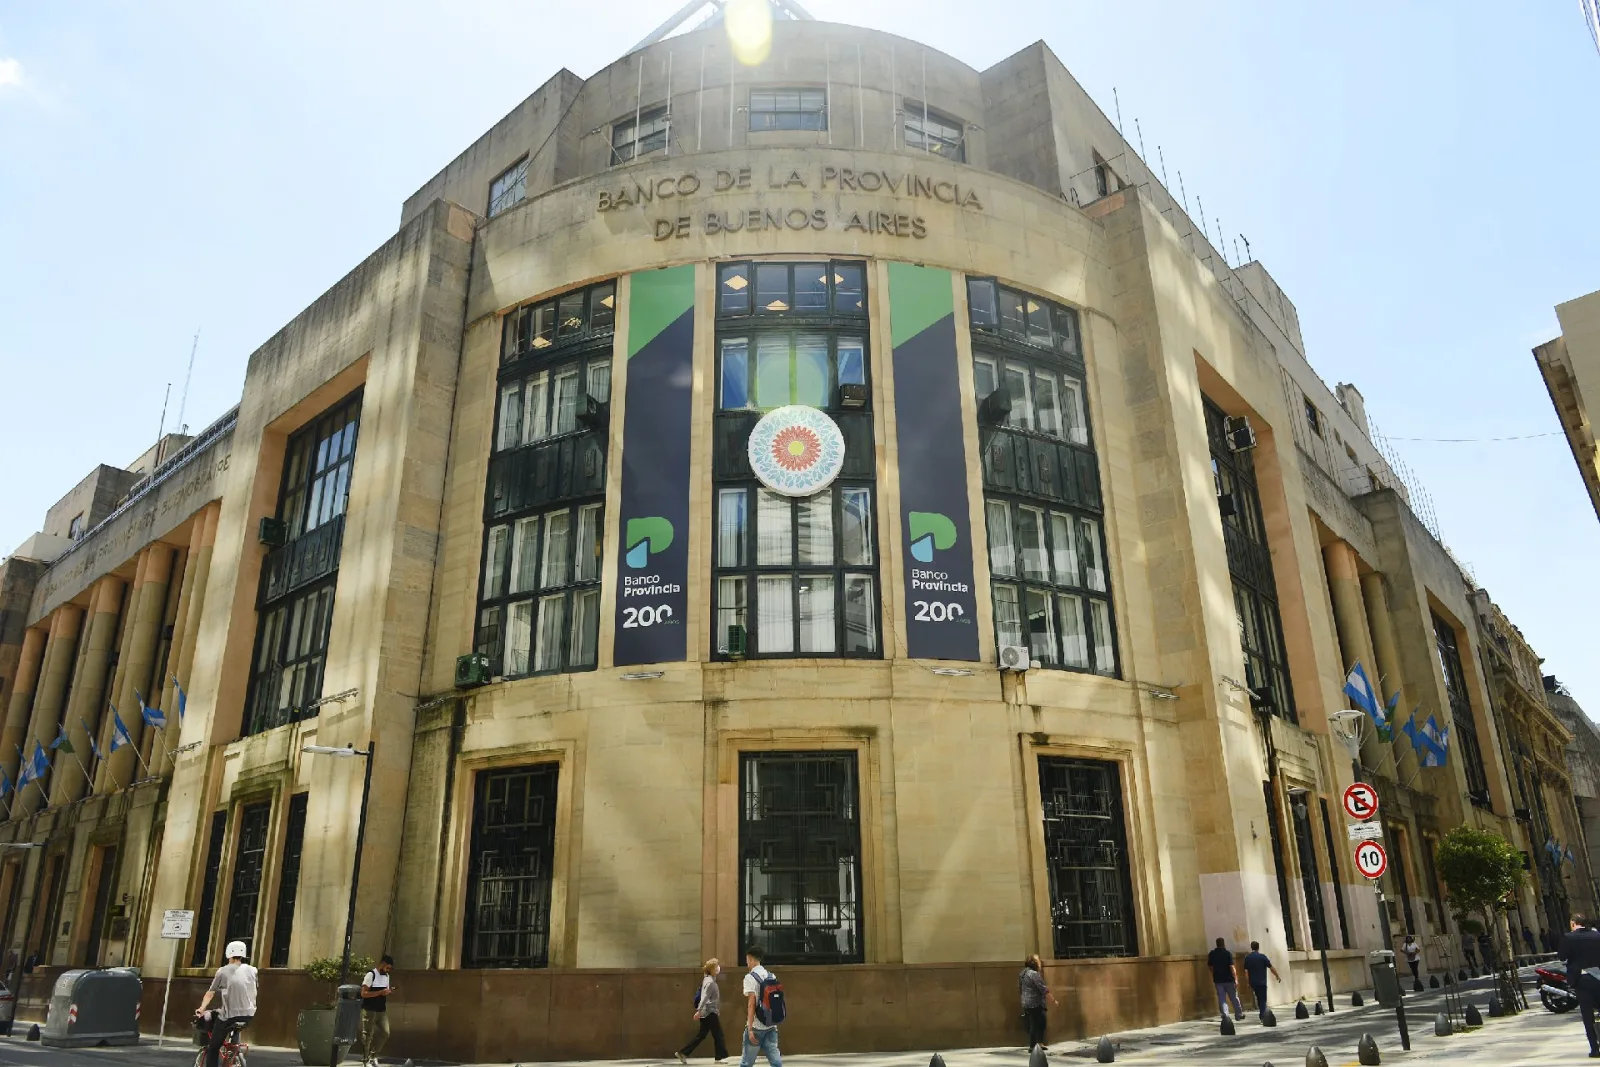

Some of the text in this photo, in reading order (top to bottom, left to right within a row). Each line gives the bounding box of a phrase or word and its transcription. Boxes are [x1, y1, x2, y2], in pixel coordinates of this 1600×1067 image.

[597, 165, 983, 212] BANCO DE LA PROVINCIA
[654, 208, 927, 241] DE BUENOS AIRES
[624, 575, 660, 586] Banco
[912, 568, 948, 580] Banco
[624, 583, 681, 597] Provincia
[912, 580, 968, 593] Provincia
[622, 604, 673, 629] 200
[913, 600, 964, 622] 200
[1361, 851, 1379, 868] 10
